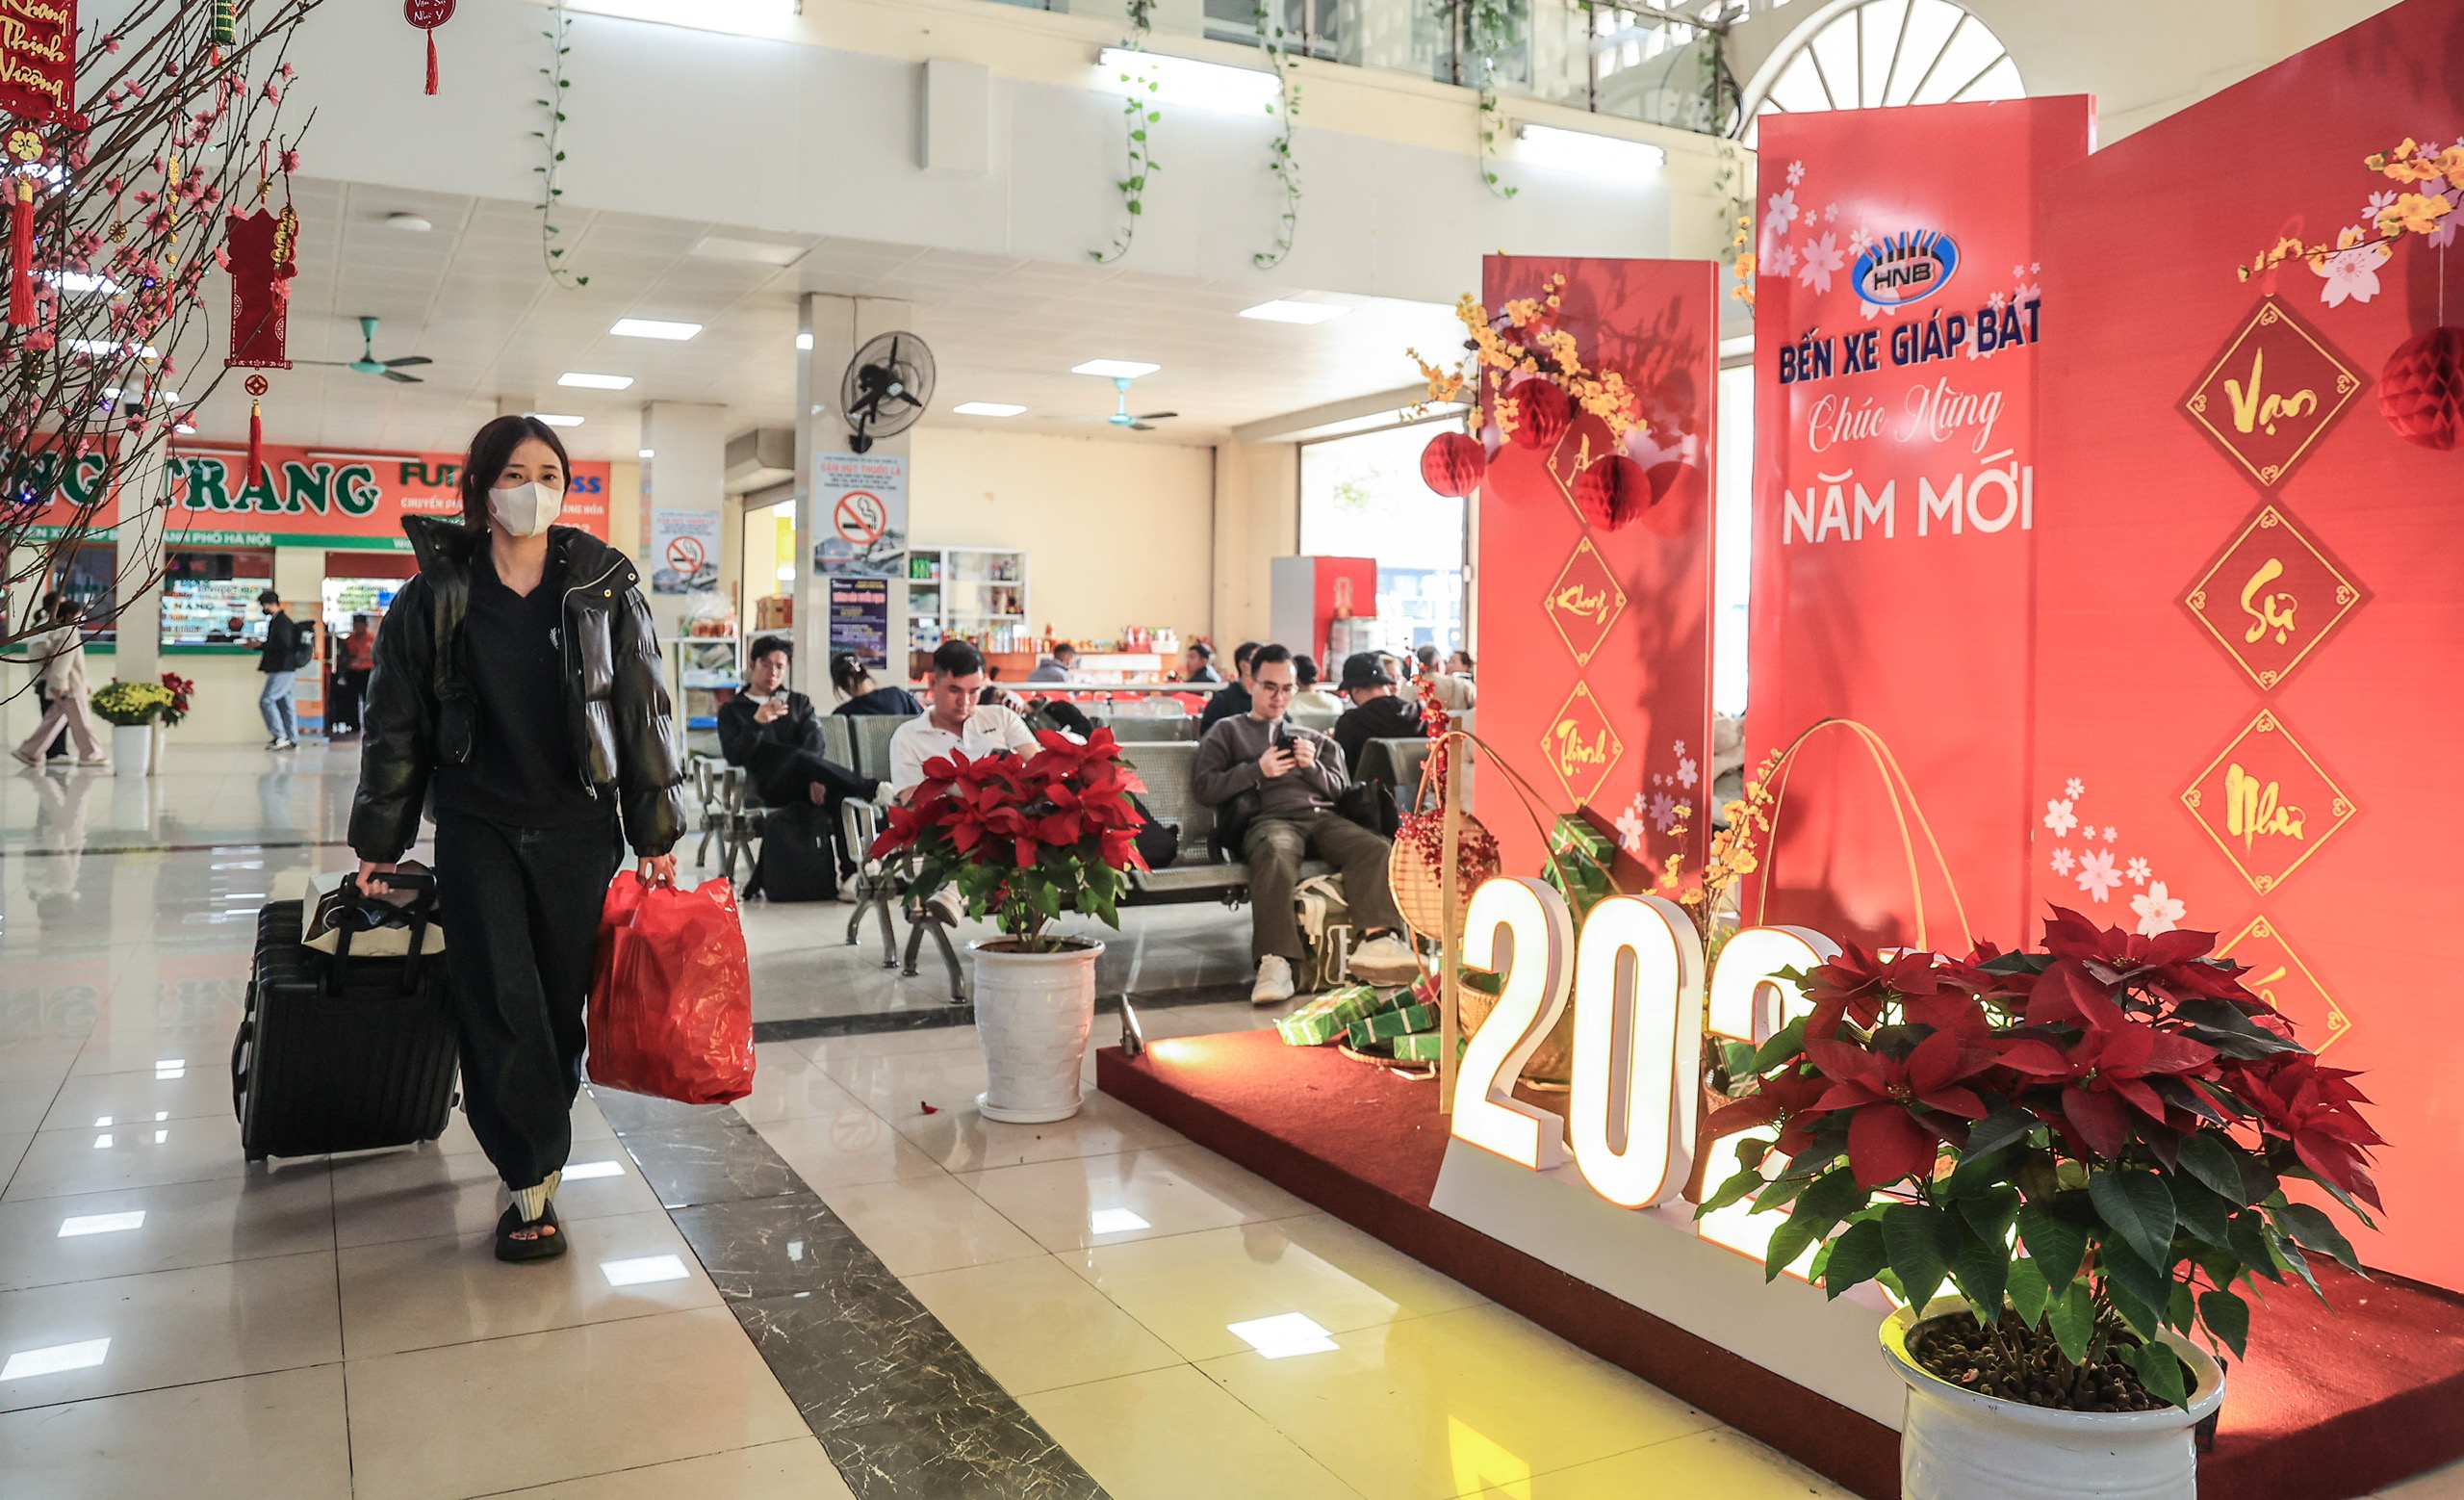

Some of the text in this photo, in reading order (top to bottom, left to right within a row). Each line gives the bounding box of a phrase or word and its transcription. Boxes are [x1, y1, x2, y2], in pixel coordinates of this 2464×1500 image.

[0, 15, 66, 62] Thịnh
[0, 48, 64, 108] Vượng
[1873, 263, 1934, 292] HNB
[1780, 294, 2042, 384] BẾN XE GIÁP BÁT
[1809, 376, 2006, 454] Chúc Mừng
[2223, 347, 2318, 433] Vạn
[400, 462, 462, 487] FUT
[1783, 448, 2034, 545] NĂM MỚI
[2241, 557, 2298, 645] Sự
[2224, 763, 2306, 858] Như
[1450, 874, 2019, 1309] 202
